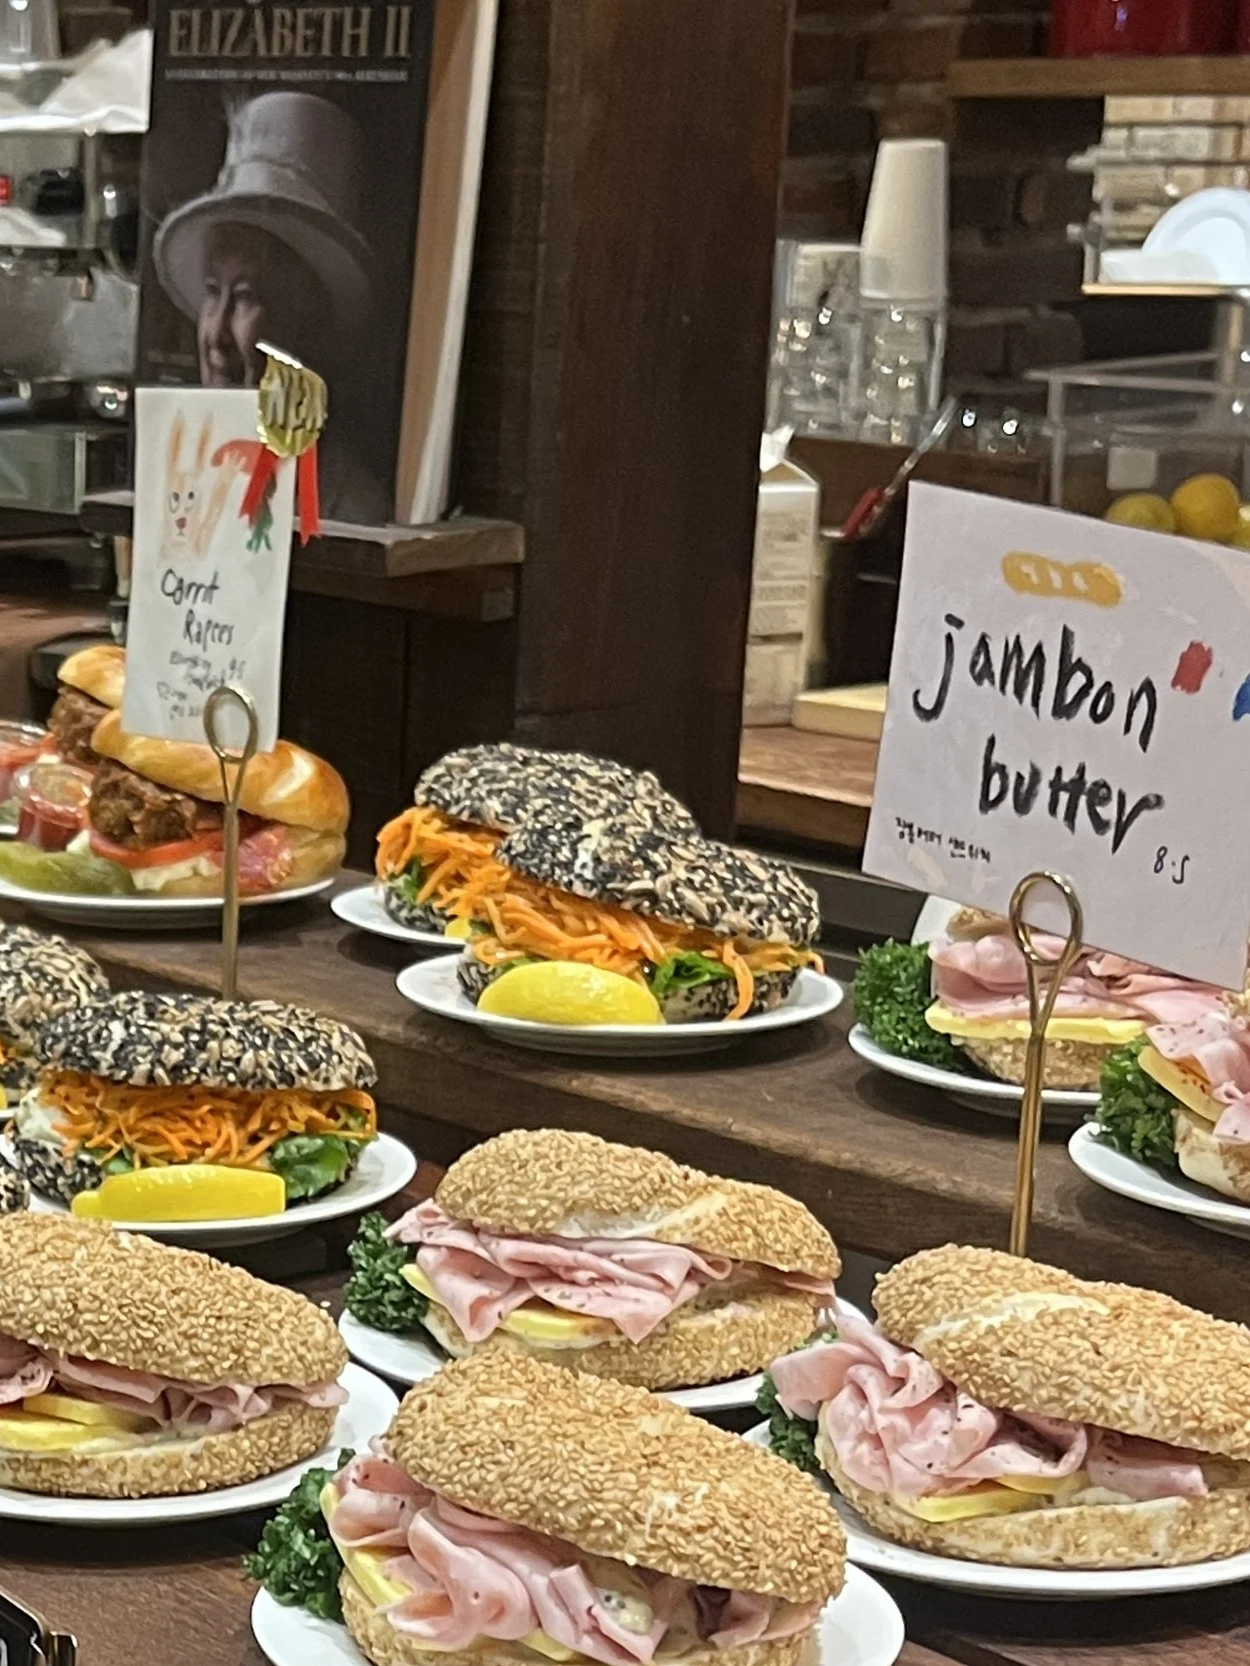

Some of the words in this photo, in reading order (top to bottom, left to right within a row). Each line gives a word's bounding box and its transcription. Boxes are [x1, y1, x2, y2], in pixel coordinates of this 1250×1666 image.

[168, 6, 372, 58] ELIZABETH
[383, 5, 412, 59] II
[912, 613, 1160, 754] jambon
[977, 733, 1167, 855] butter
